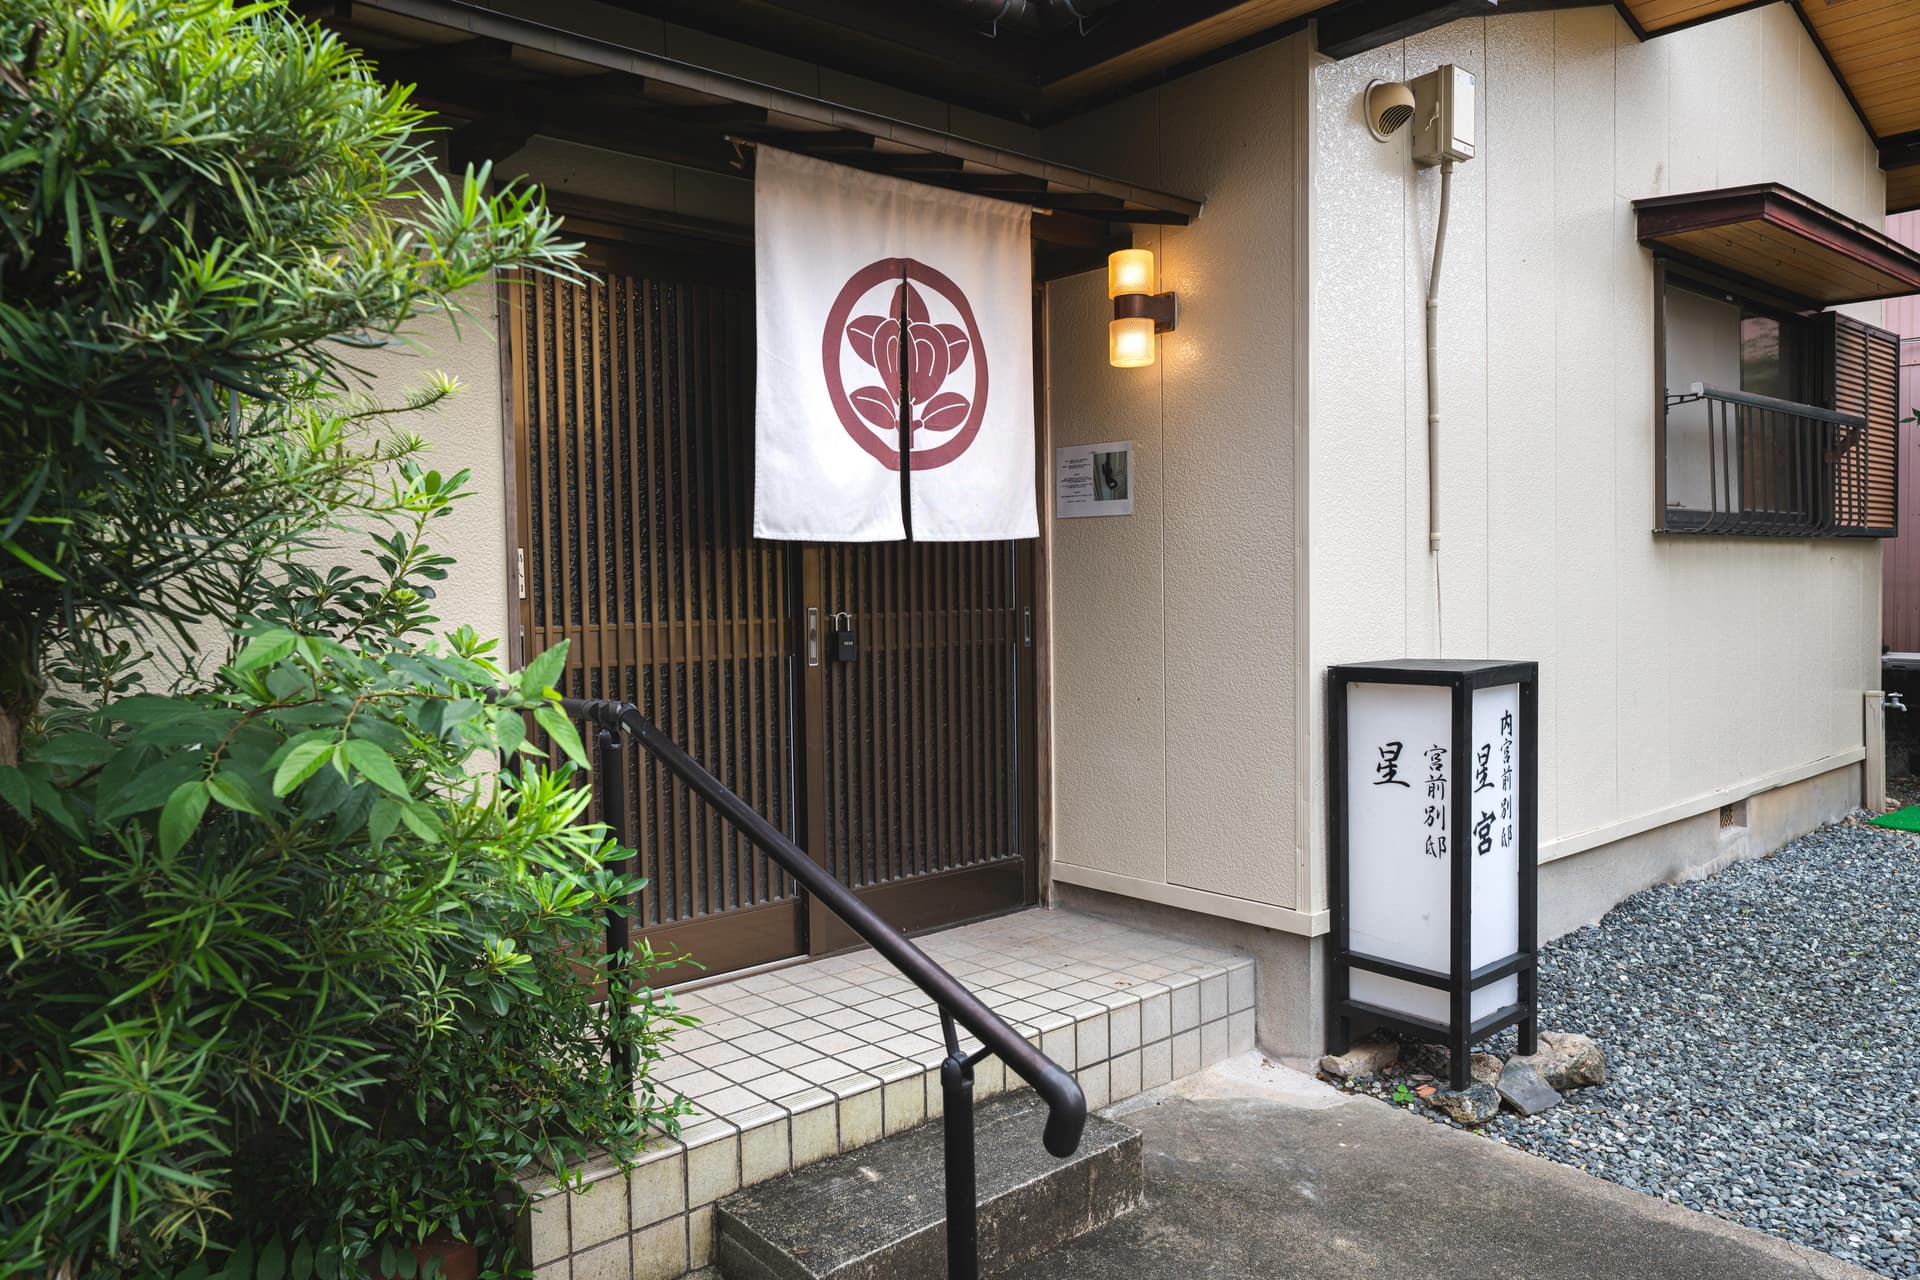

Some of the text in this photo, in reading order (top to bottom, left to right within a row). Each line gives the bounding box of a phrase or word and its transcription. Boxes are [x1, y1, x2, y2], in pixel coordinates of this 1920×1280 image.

[1373, 741, 1411, 788] 星
[1423, 744, 1448, 859] 宮前別邸
[1472, 743, 1496, 856] 星宮
[1500, 709, 1513, 848] 内宮前別邸
